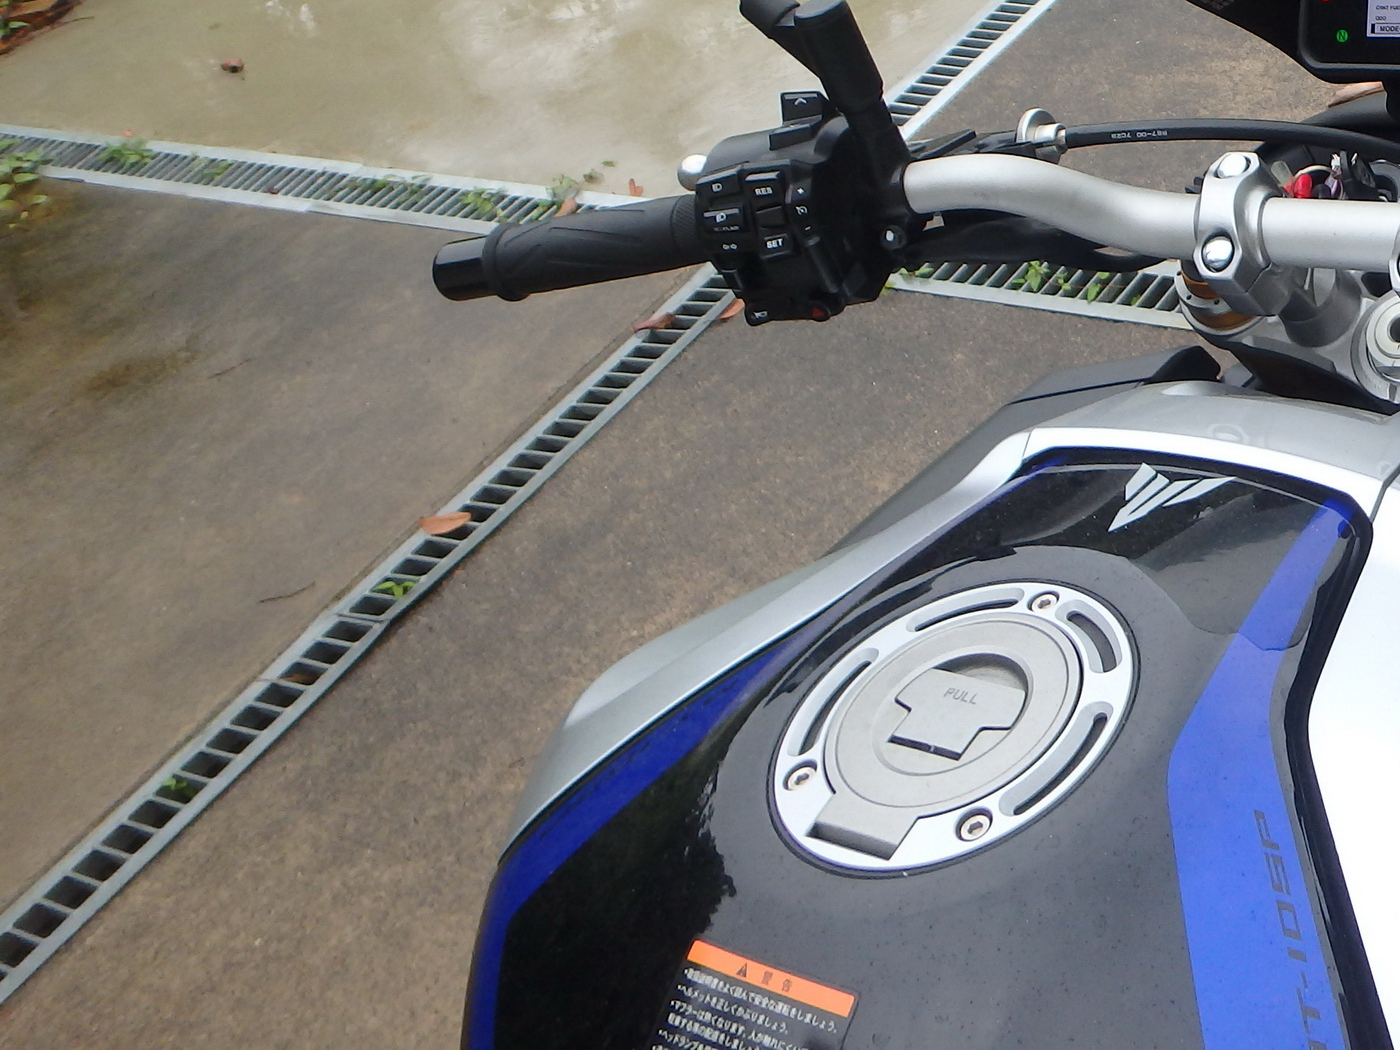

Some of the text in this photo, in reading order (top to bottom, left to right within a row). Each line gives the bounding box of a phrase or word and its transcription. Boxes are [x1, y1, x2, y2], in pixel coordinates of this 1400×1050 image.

[754, 186, 773, 196] RES
[766, 238, 783, 248] SET
[943, 686, 977, 705] PULL
[1253, 809, 1328, 1050] T-10SP
